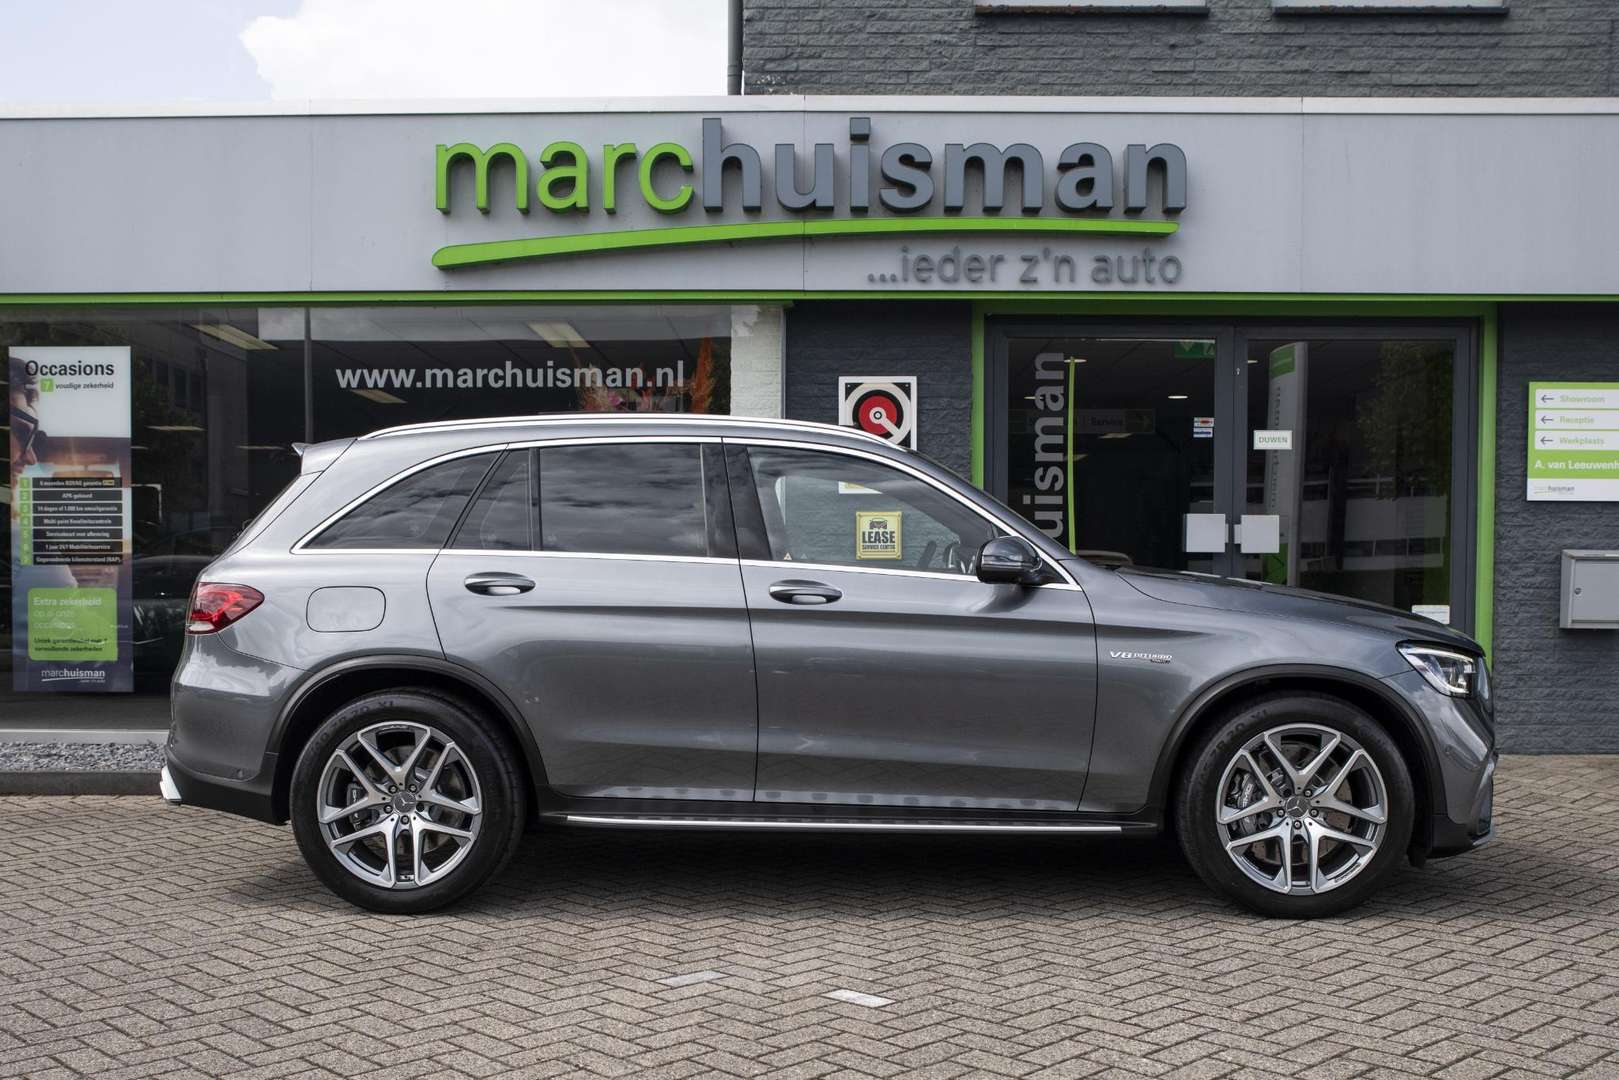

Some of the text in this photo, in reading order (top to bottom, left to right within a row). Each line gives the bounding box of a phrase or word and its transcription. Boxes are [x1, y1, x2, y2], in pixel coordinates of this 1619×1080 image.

[435, 117, 1188, 214] marchuisman
[1018, 247, 1076, 284] z'n
[1090, 249, 1184, 284] auto
[25, 360, 115, 376] Occasions
[335, 360, 685, 390] www.marchuisman.nl
[55, 382, 81, 390] voudige
[1560, 394, 1606, 403] Showroom
[1560, 415, 1595, 425] Receptie
[1023, 352, 1065, 538] uisman
[1258, 436, 1288, 444] DUWEN
[1560, 436, 1605, 446] Werkplaats
[1535, 460, 1545, 469] A.
[1548, 461, 1565, 469] van
[862, 531, 896, 544] LEASE
[1110, 651, 1132, 659] V8
[41, 667, 106, 678] marchuisman
